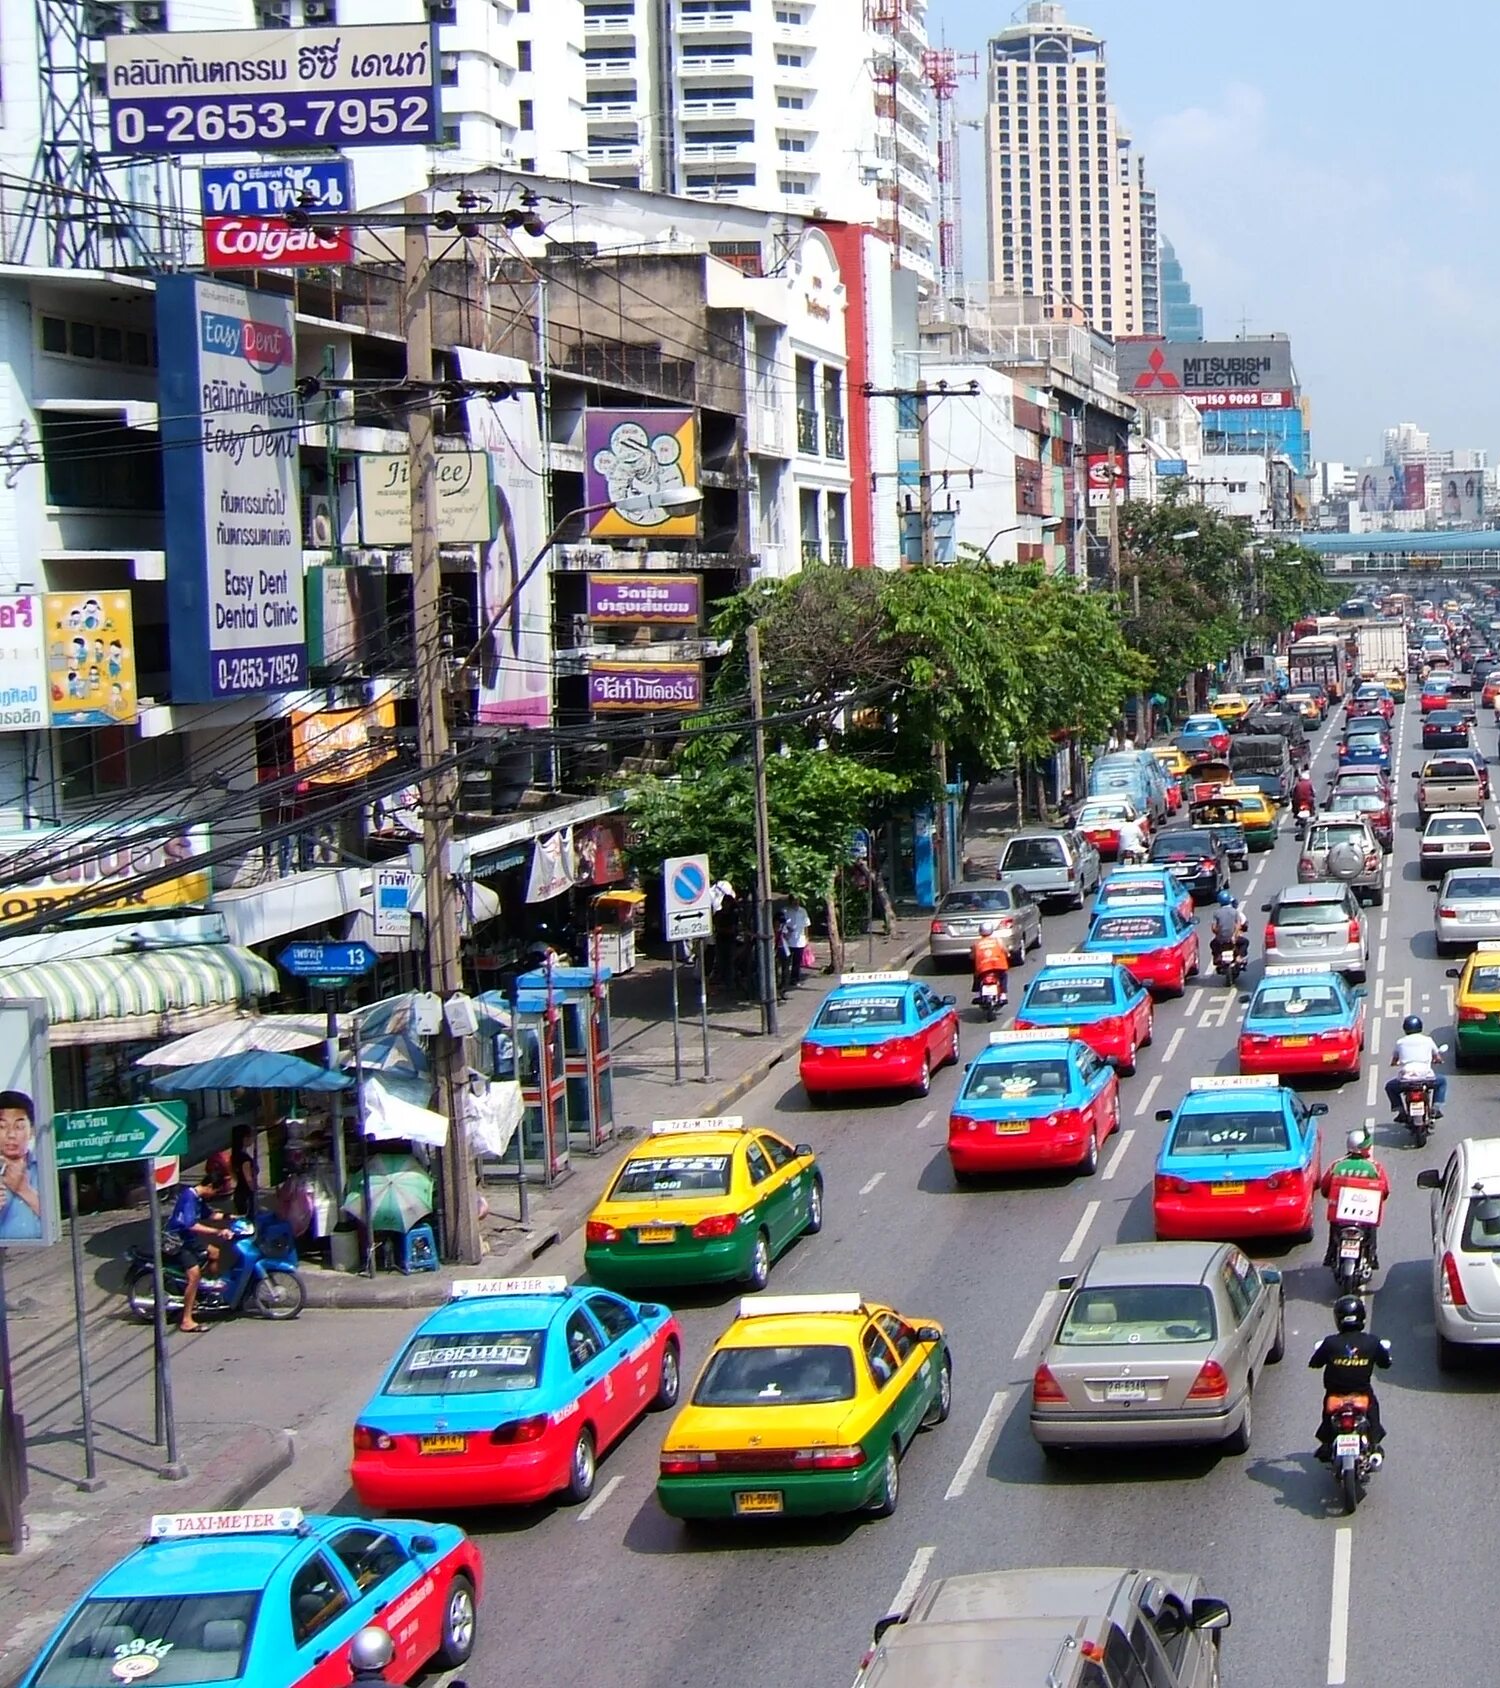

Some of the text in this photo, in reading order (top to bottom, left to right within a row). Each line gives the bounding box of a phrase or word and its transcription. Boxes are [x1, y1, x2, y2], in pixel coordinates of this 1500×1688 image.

[113, 38, 429, 87] คลินิกทันตกรรม อีซี่ เดนท์
[116, 96, 429, 145] 0-2653-7952
[216, 222, 339, 260] Colgate
[204, 314, 283, 354] Easy Dent
[1183, 356, 1271, 372] MITSUBISHI
[1183, 372, 1261, 387] ELECTRIC
[1207, 394, 1226, 405] ISO
[1229, 393, 1258, 405] 9002
[204, 419, 297, 466] Easy Dent
[225, 569, 288, 600] Easy Dent
[617, 586, 669, 600] วิตามิน
[216, 600, 298, 630] Dental Clinic
[597, 599, 690, 615] บำรุงเส้นผม
[218, 653, 300, 690] 0-2653-7952
[347, 948, 365, 966] 13
[175, 1515, 274, 1531] TAXI-METER
[113, 1638, 174, 1660] 3944
